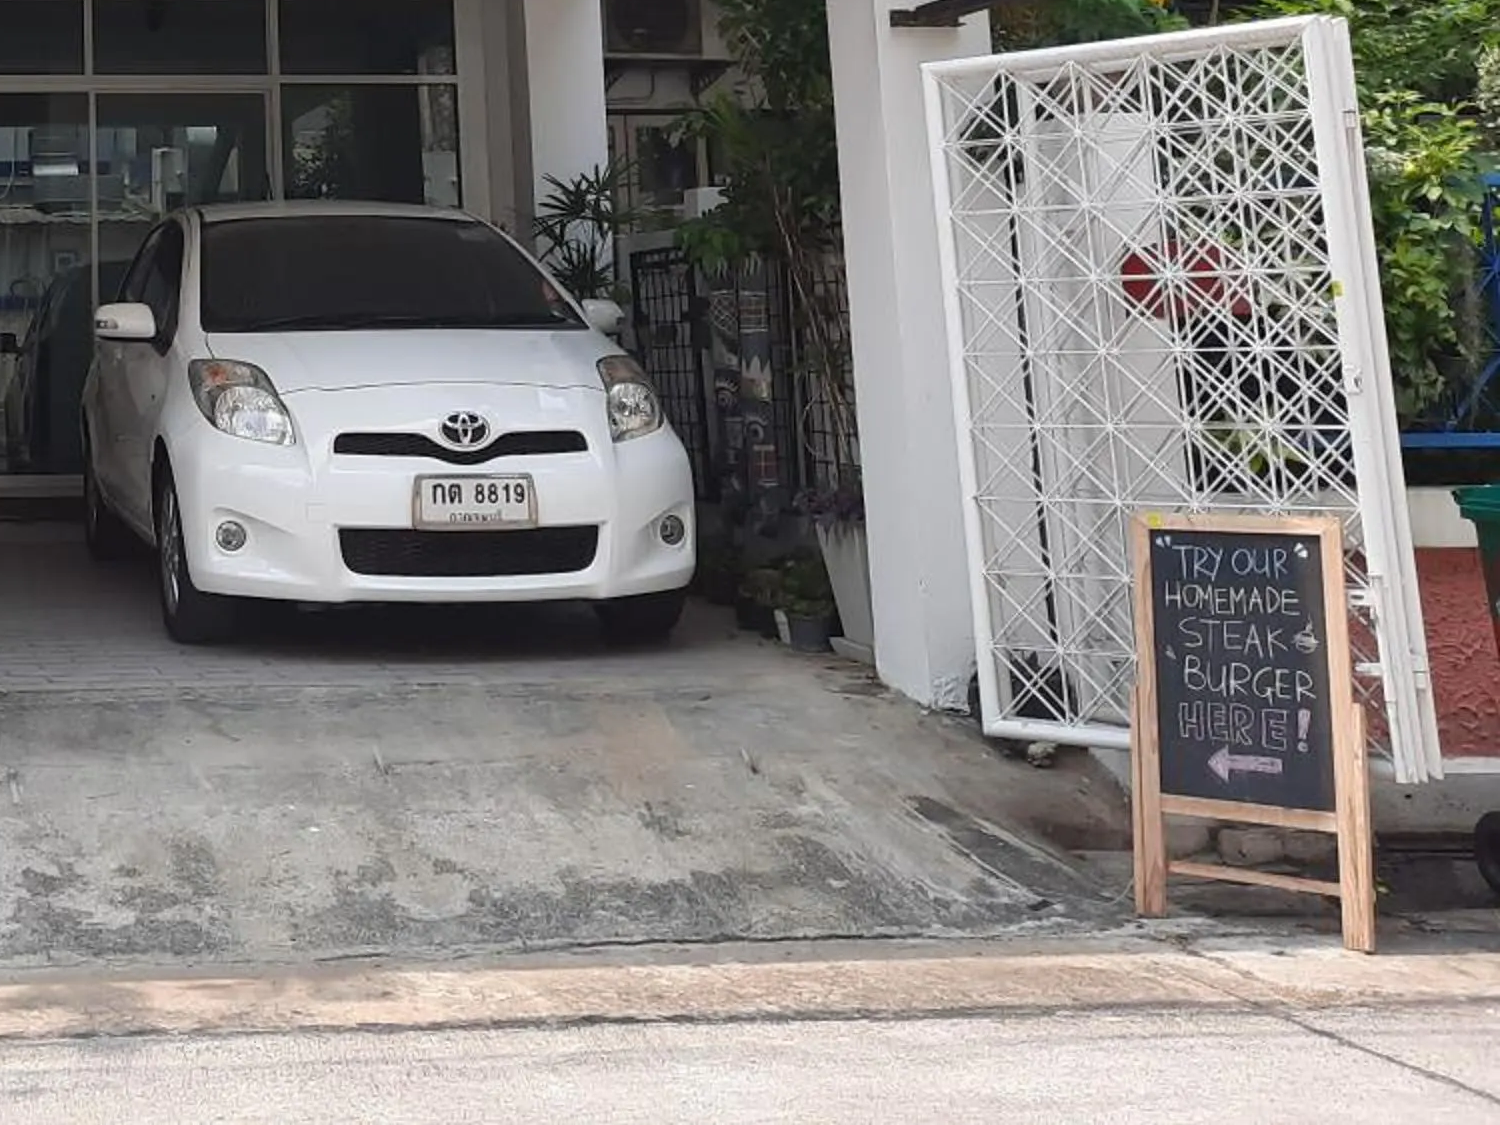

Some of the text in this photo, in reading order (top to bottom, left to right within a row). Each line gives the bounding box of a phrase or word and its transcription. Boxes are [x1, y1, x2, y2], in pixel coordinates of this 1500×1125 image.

[475, 483, 525, 504] 8819
[1231, 548, 1288, 579] OUR
[1165, 580, 1300, 616] HOMEMADE
[1178, 616, 1289, 659] STEAK
[1183, 654, 1316, 705] BURGER
